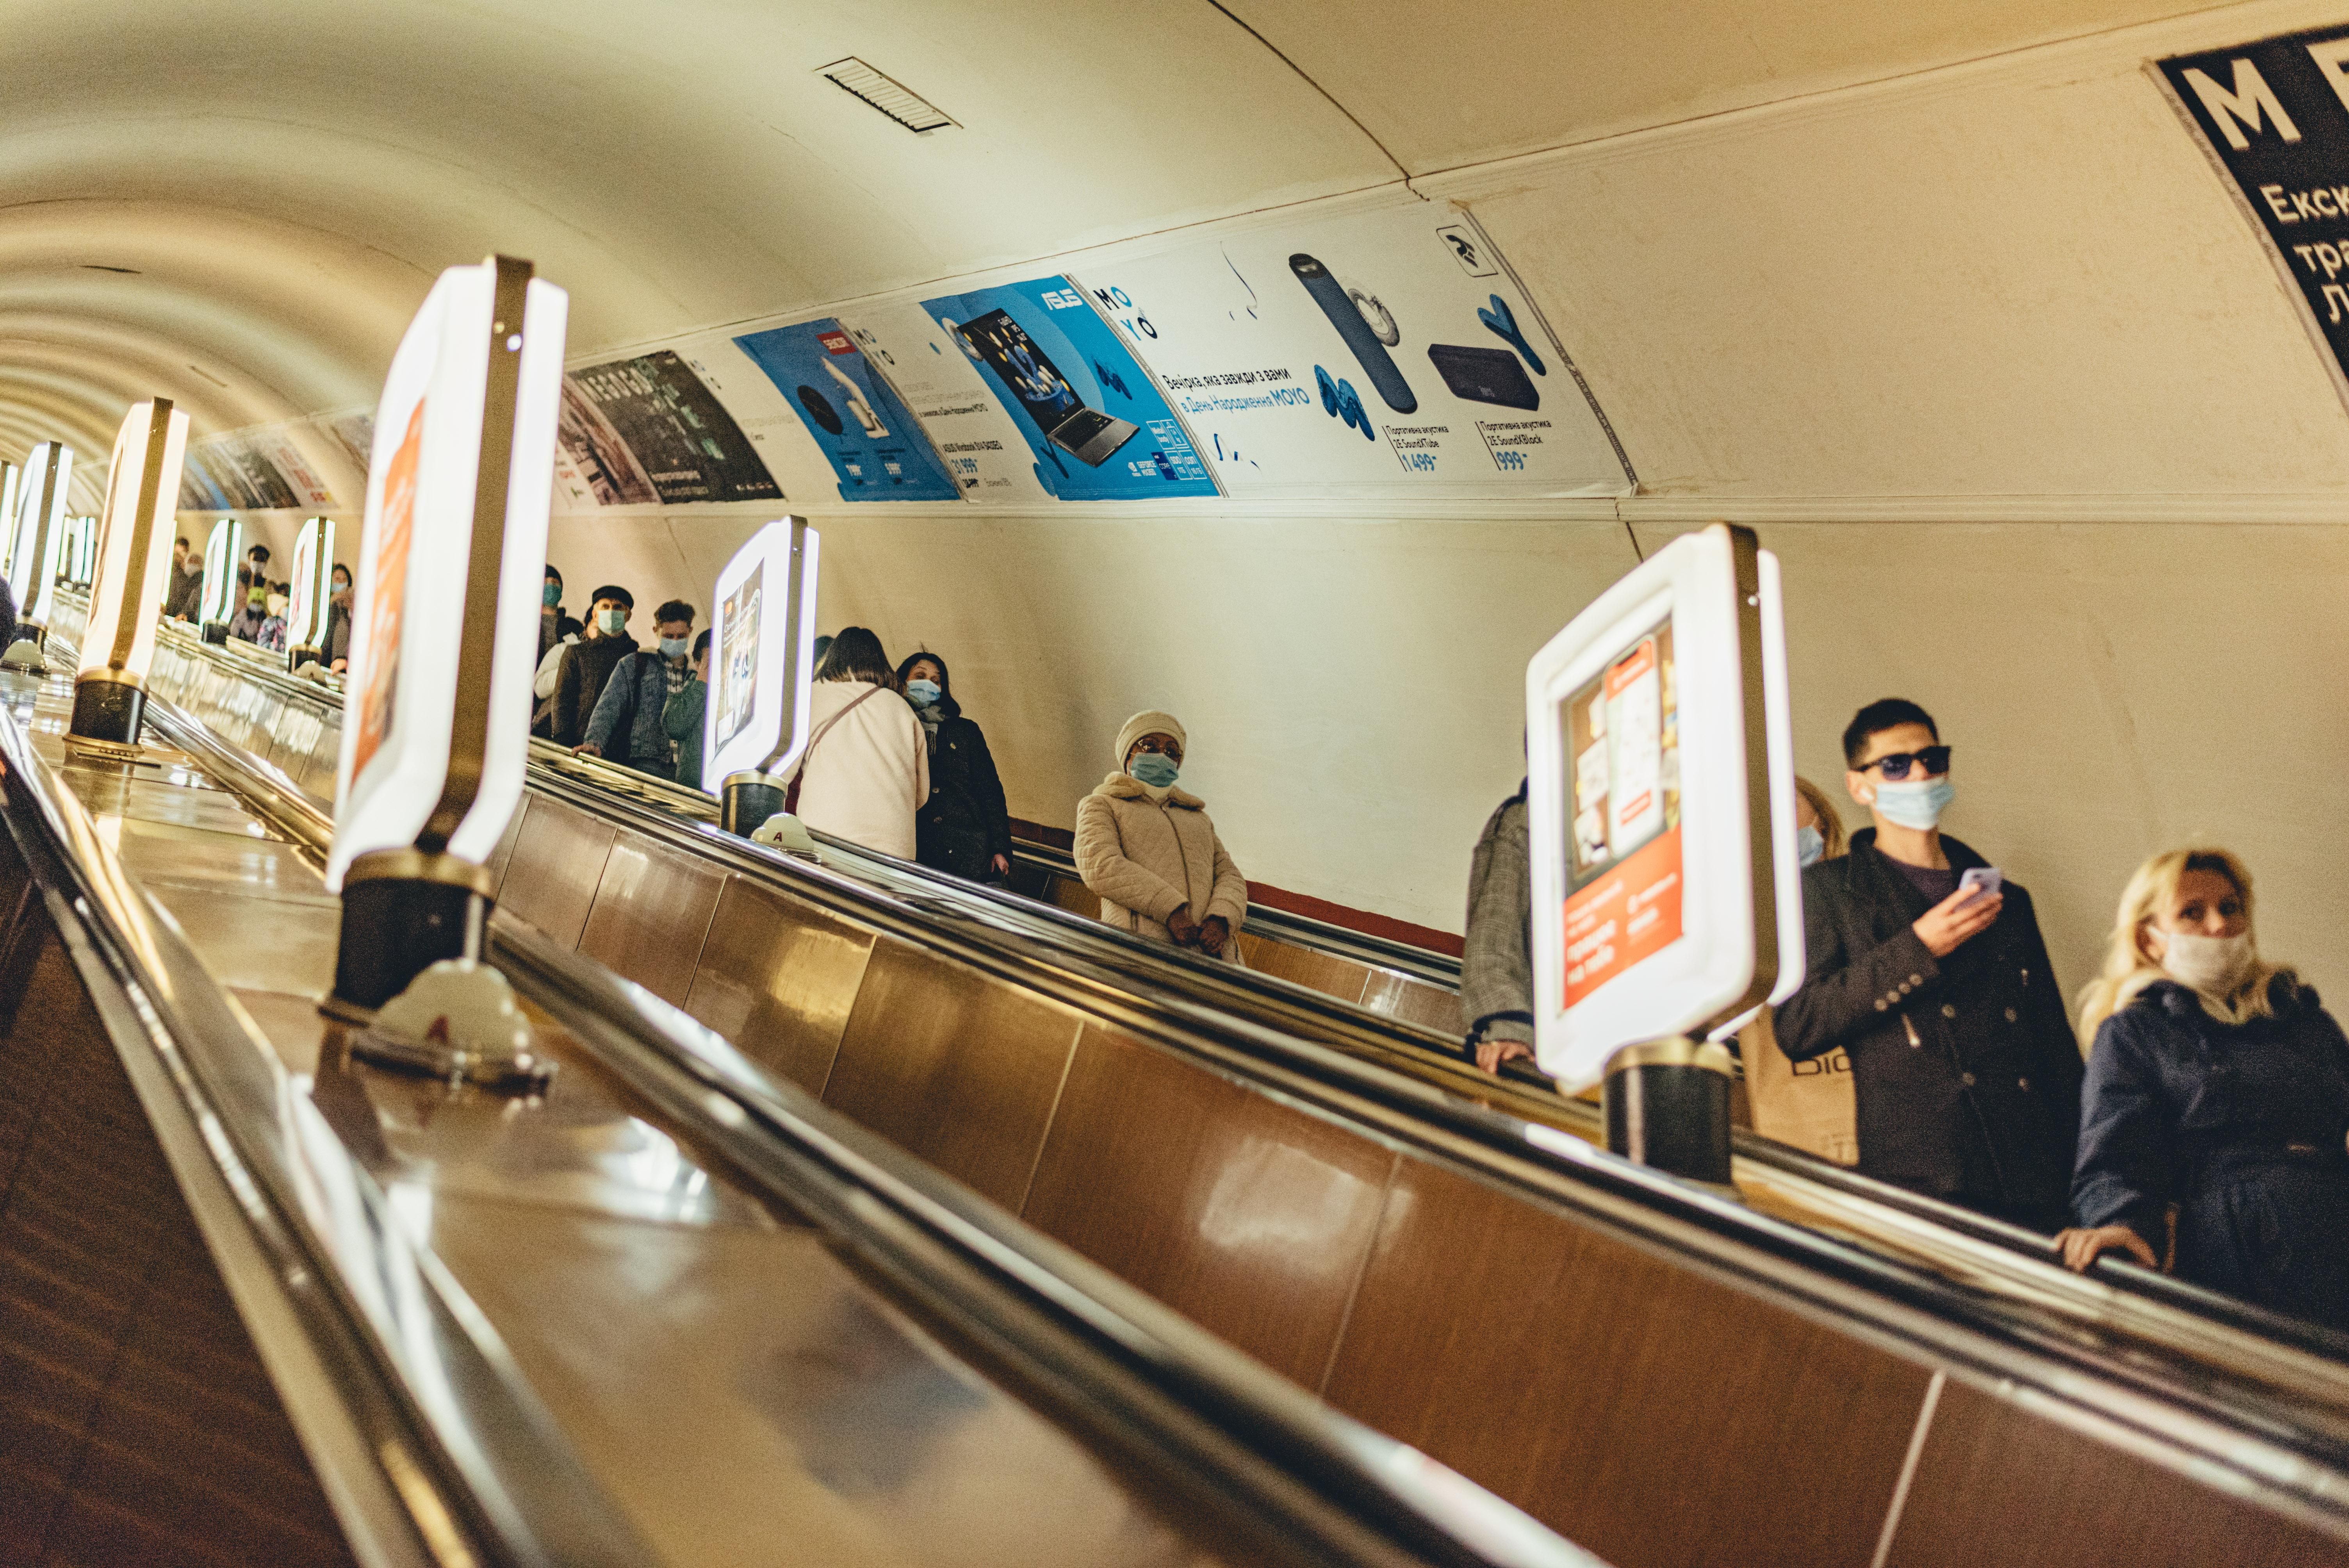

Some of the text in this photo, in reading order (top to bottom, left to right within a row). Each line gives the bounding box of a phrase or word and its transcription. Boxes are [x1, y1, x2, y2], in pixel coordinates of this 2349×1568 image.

[1041, 289, 1083, 310] ASUS
[1162, 368, 1292, 392] Вечірка, яка завжди з вами
[1181, 388, 1310, 414] в День Народження MOYO
[1385, 426, 1449, 437] Портативна акустика
[1480, 421, 1552, 433] Портативна акустика
[1393, 438, 1440, 448] 2E SoundXTube
[1487, 433, 1543, 445] 2E SoundXBlock
